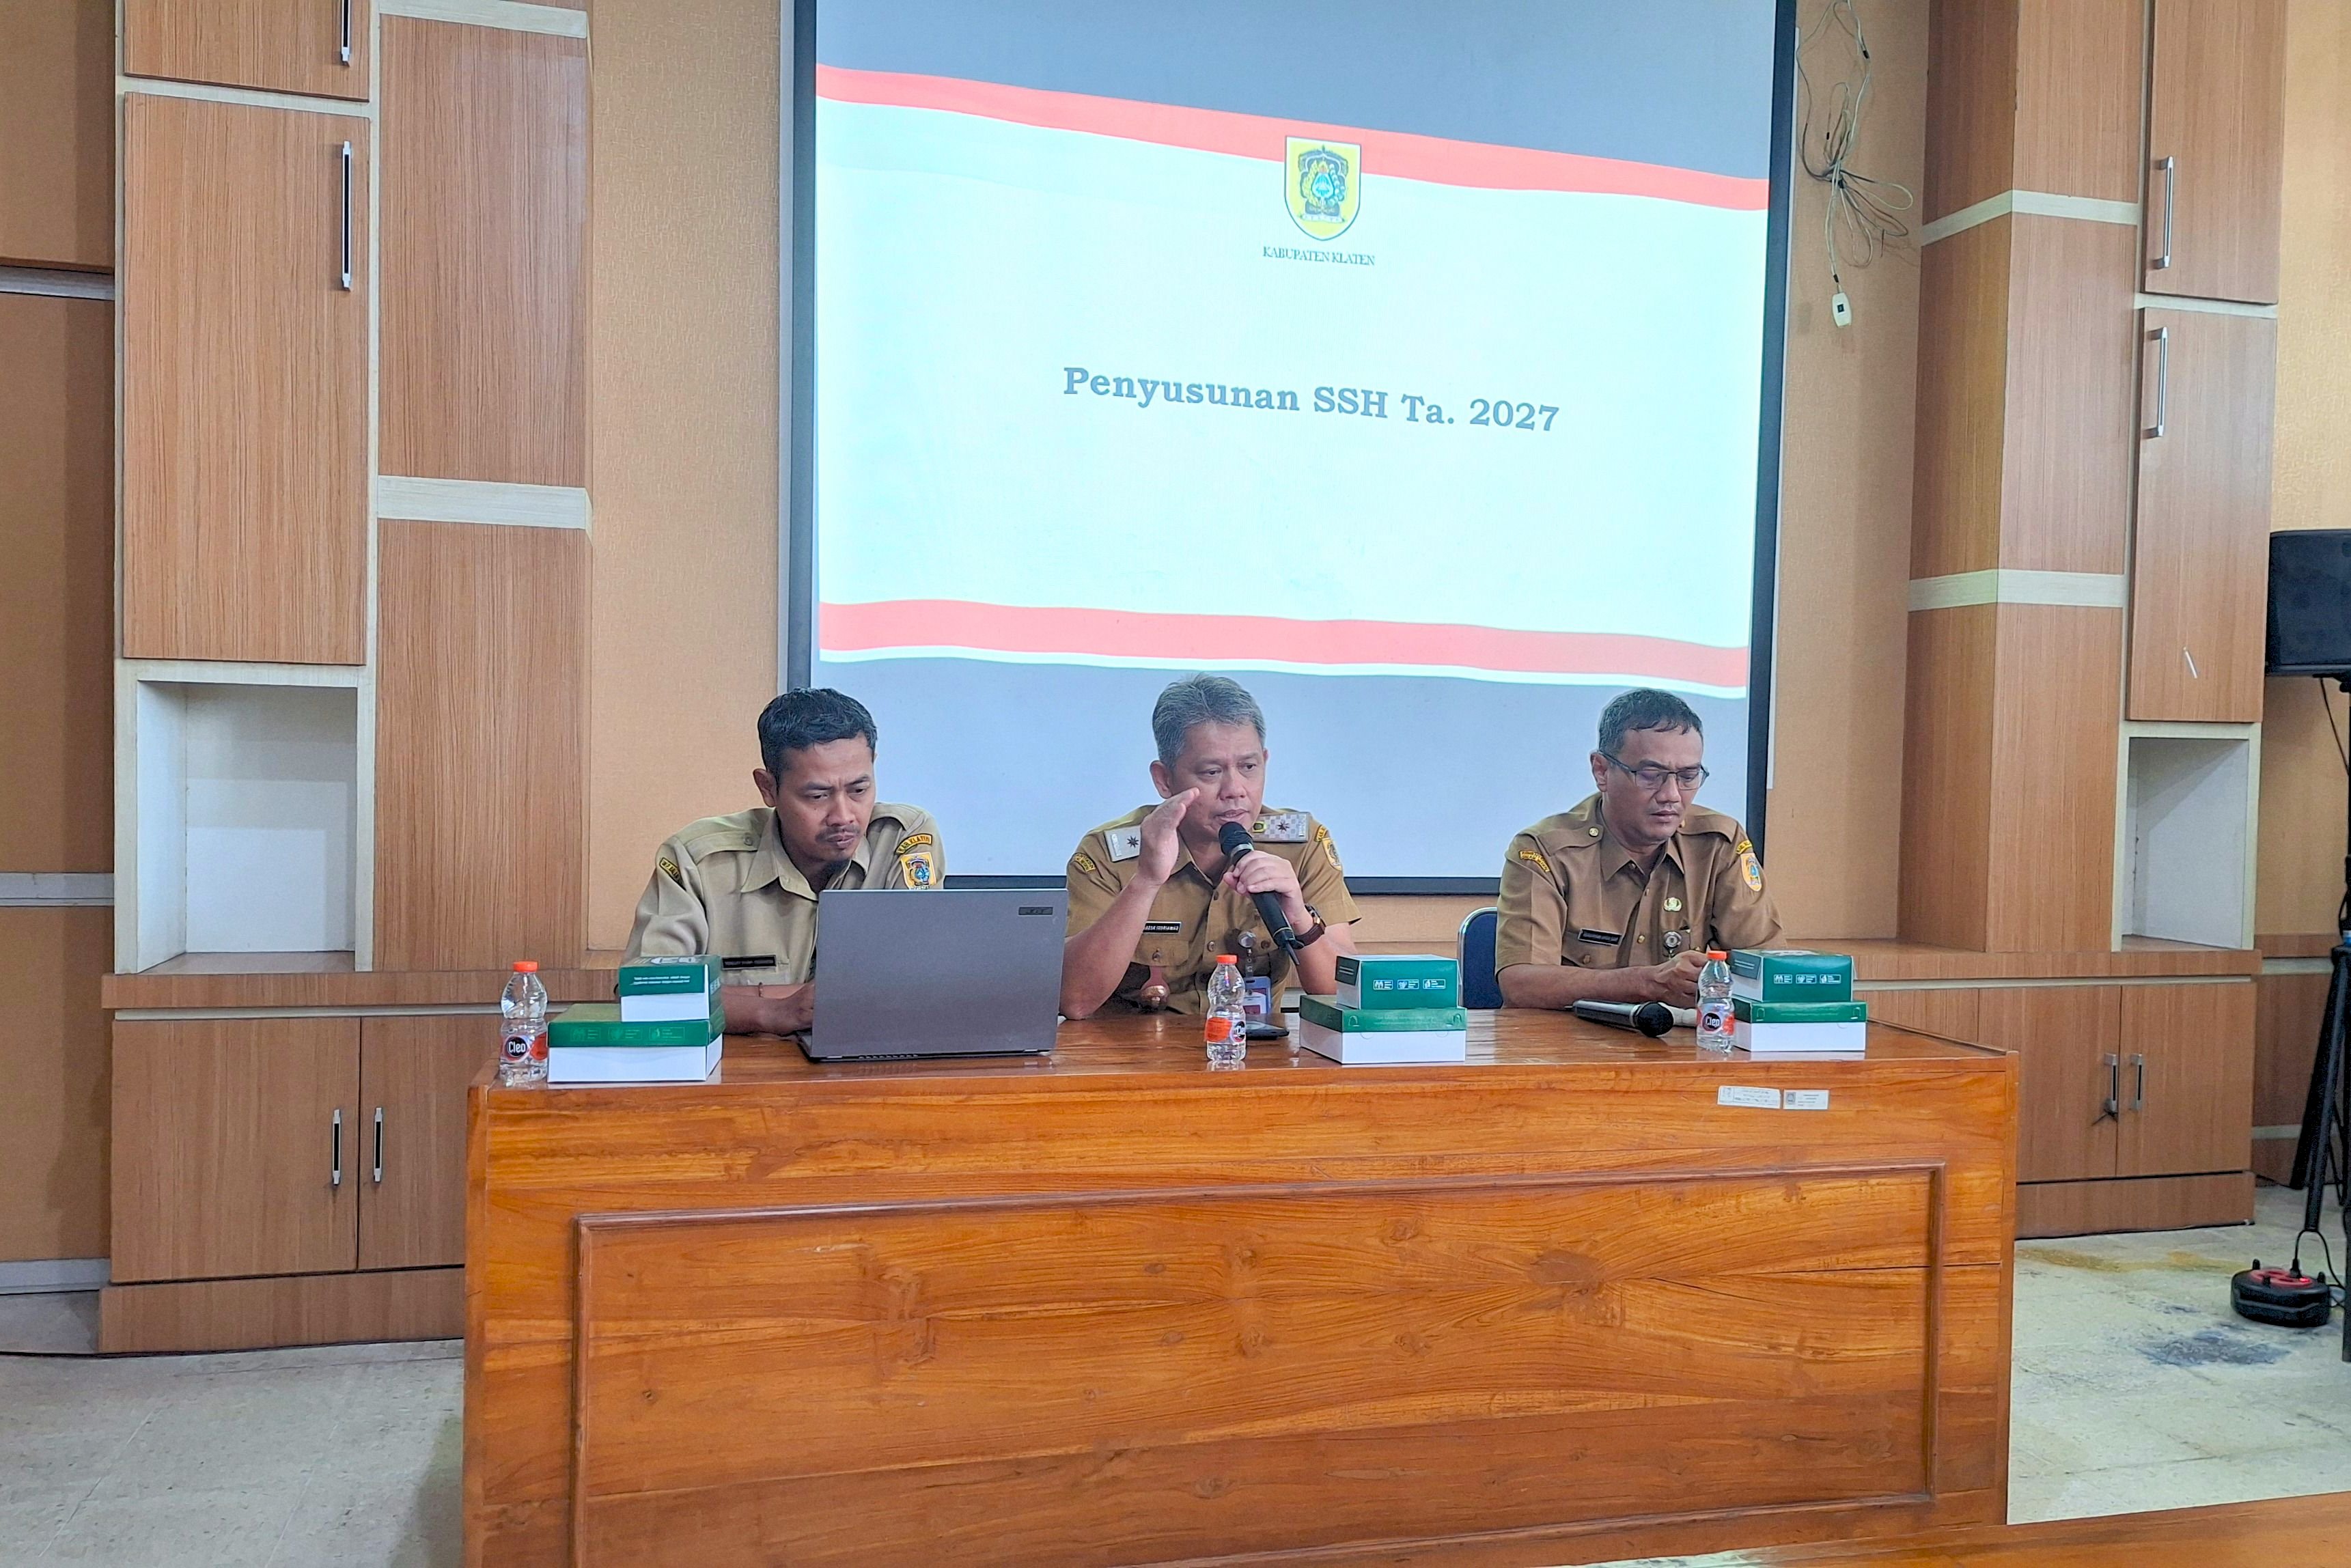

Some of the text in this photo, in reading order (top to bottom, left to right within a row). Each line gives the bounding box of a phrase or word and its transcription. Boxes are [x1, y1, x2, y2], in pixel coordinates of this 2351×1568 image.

[1262, 246, 1376, 266] KABUPATEN KLATEN
[1063, 367, 1559, 432] Penyusunan SSH Ta. 2027
[1705, 1015, 1721, 1027] Cleo
[507, 1041, 526, 1054] Cleo
